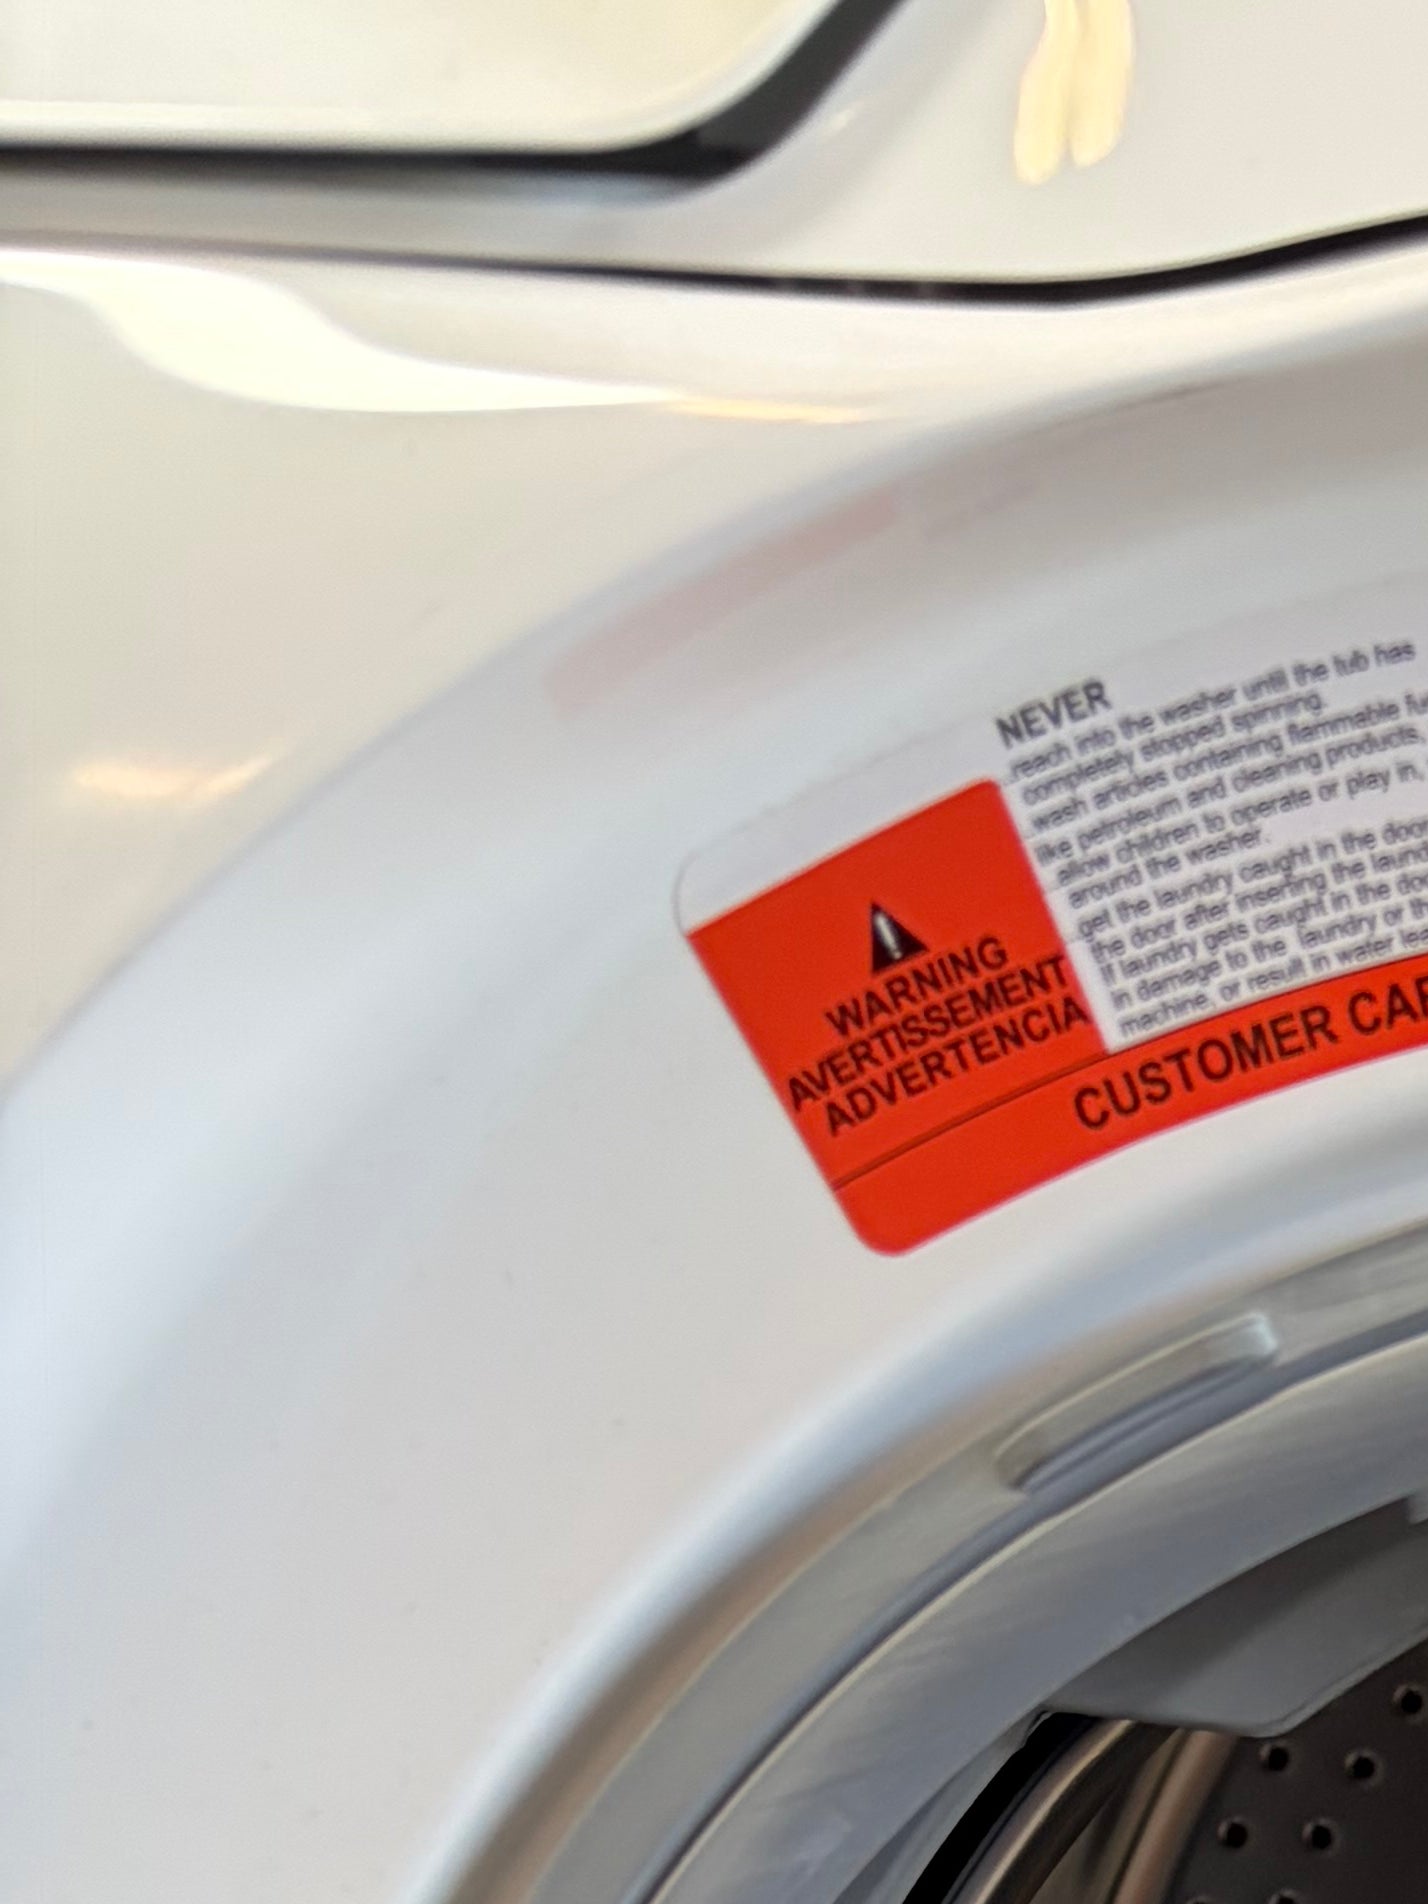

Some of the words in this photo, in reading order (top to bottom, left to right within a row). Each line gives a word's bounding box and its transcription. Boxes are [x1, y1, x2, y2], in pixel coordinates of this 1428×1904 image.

[995, 680, 1111, 748] NEVER
[1010, 741, 1071, 780] reach
[1074, 728, 1116, 752] into
[1117, 714, 1155, 740] the
[1158, 687, 1237, 726] washer
[1242, 669, 1288, 701] until
[1293, 662, 1330, 686] the
[1332, 650, 1370, 677] tub
[1373, 641, 1416, 665] has
[788, 952, 1066, 1112] AVERTISSEMENT
[824, 935, 1008, 1038] WARNING
[825, 995, 1091, 1137] ADVERTENCIA
[1073, 1006, 1338, 1130] CUSTOMER
